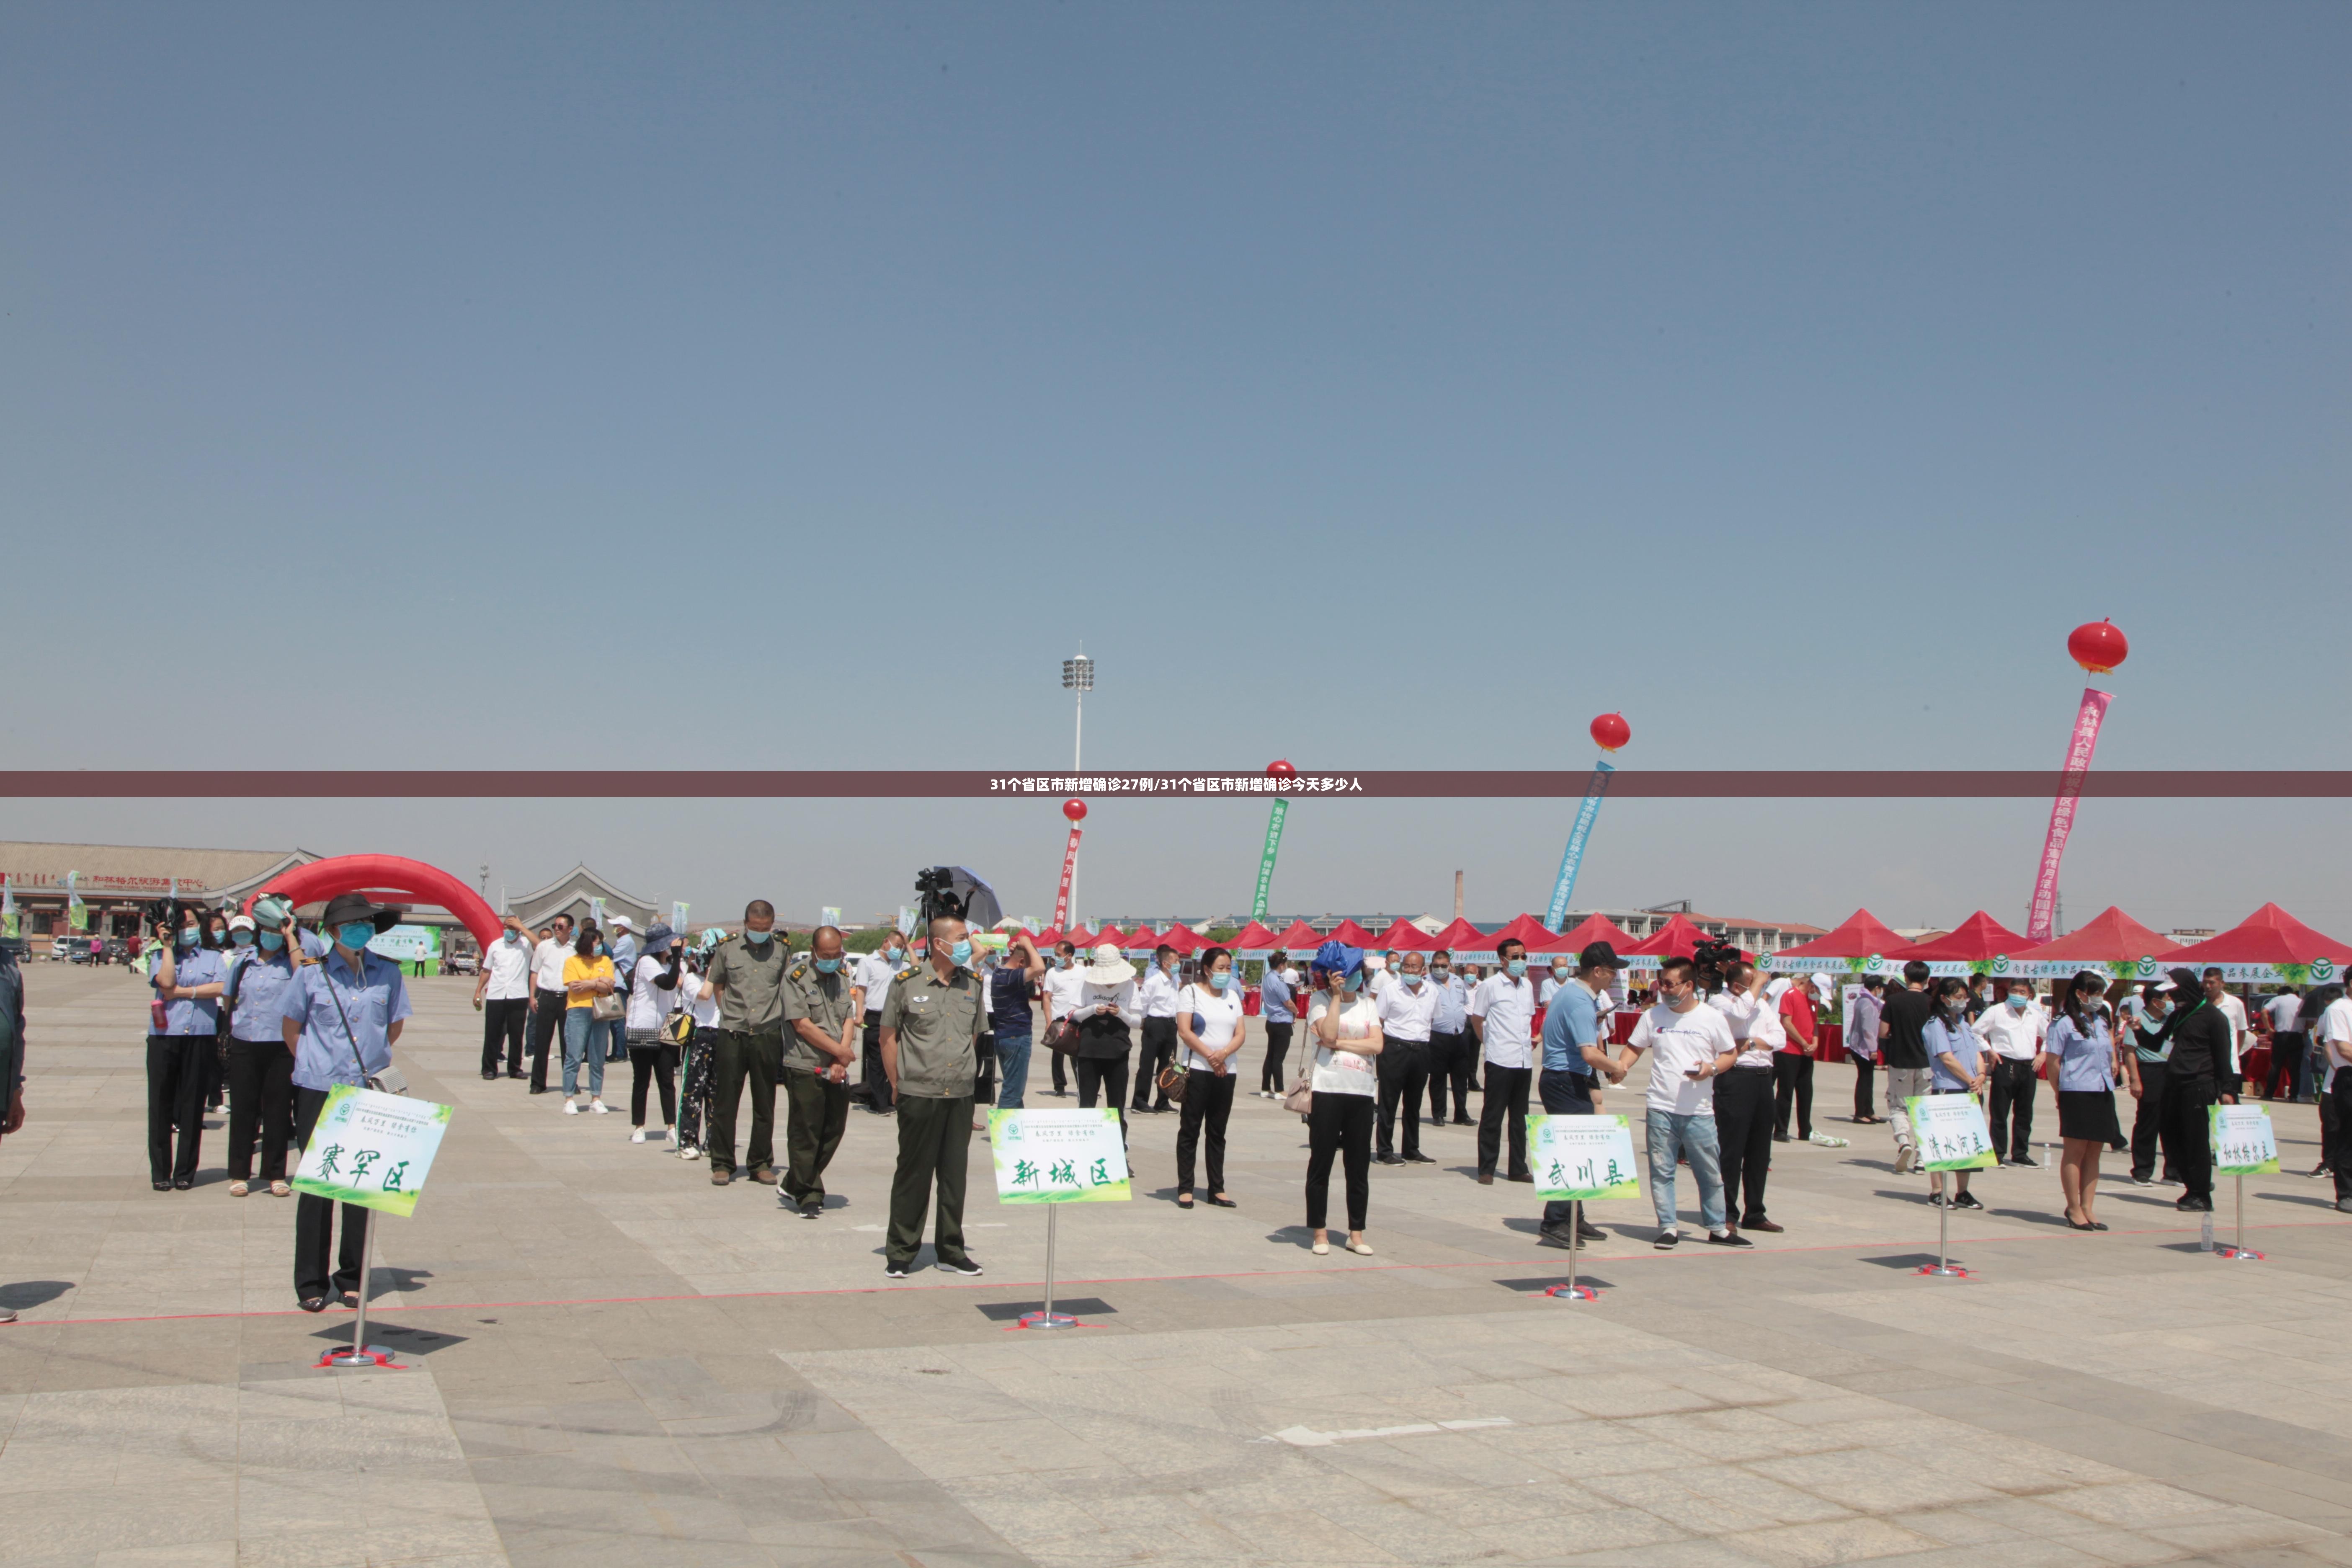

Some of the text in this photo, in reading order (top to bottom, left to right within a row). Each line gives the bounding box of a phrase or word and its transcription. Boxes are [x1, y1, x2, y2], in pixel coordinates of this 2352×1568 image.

[1061, 838, 1078, 887] 春风万里
[1656, 1026, 1702, 1037] Champion
[1928, 1132, 1984, 1161] 清水河县
[2223, 1140, 2269, 1164] 和林格尔县
[315, 1142, 410, 1193] 赛罕区
[1012, 1157, 1112, 1191] 新城区
[1548, 1158, 1624, 1189] 武川县
